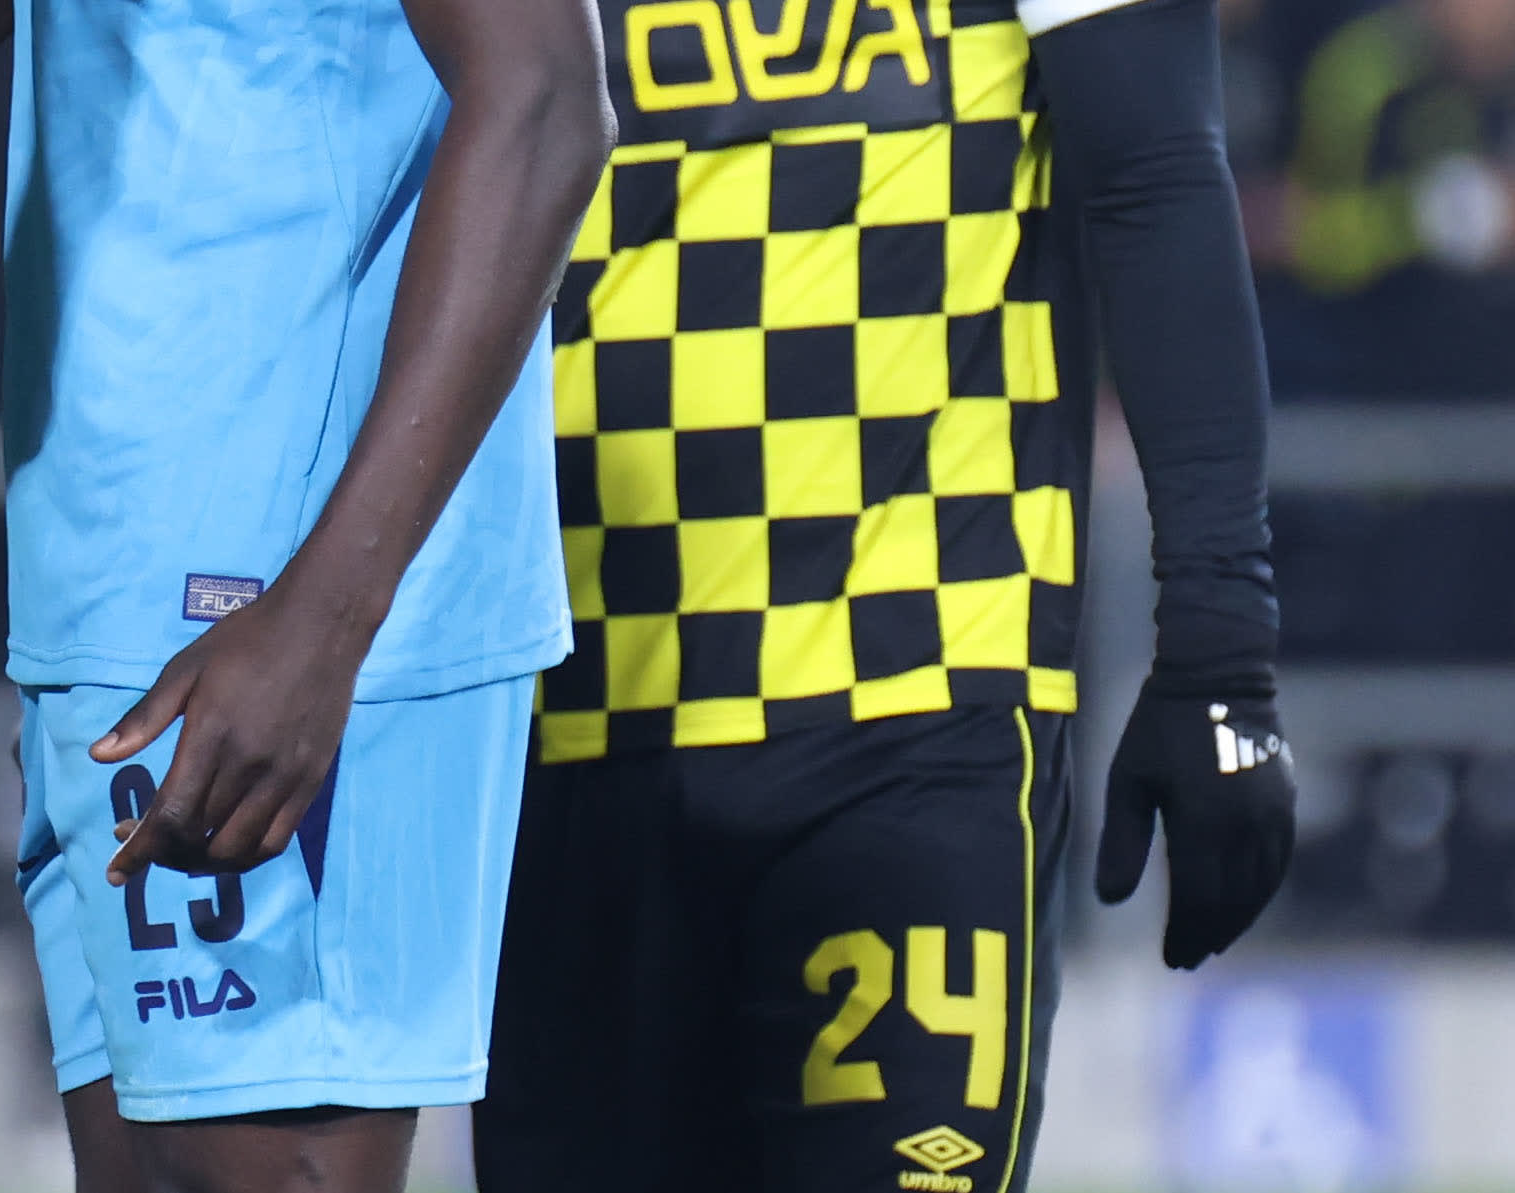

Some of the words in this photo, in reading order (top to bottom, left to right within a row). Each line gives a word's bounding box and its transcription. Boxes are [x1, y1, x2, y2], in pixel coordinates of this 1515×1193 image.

[200, 593, 243, 611] FILA
[135, 969, 256, 1024] FILA
[802, 925, 1008, 1109] 24
[899, 1170, 973, 1193] umbro
